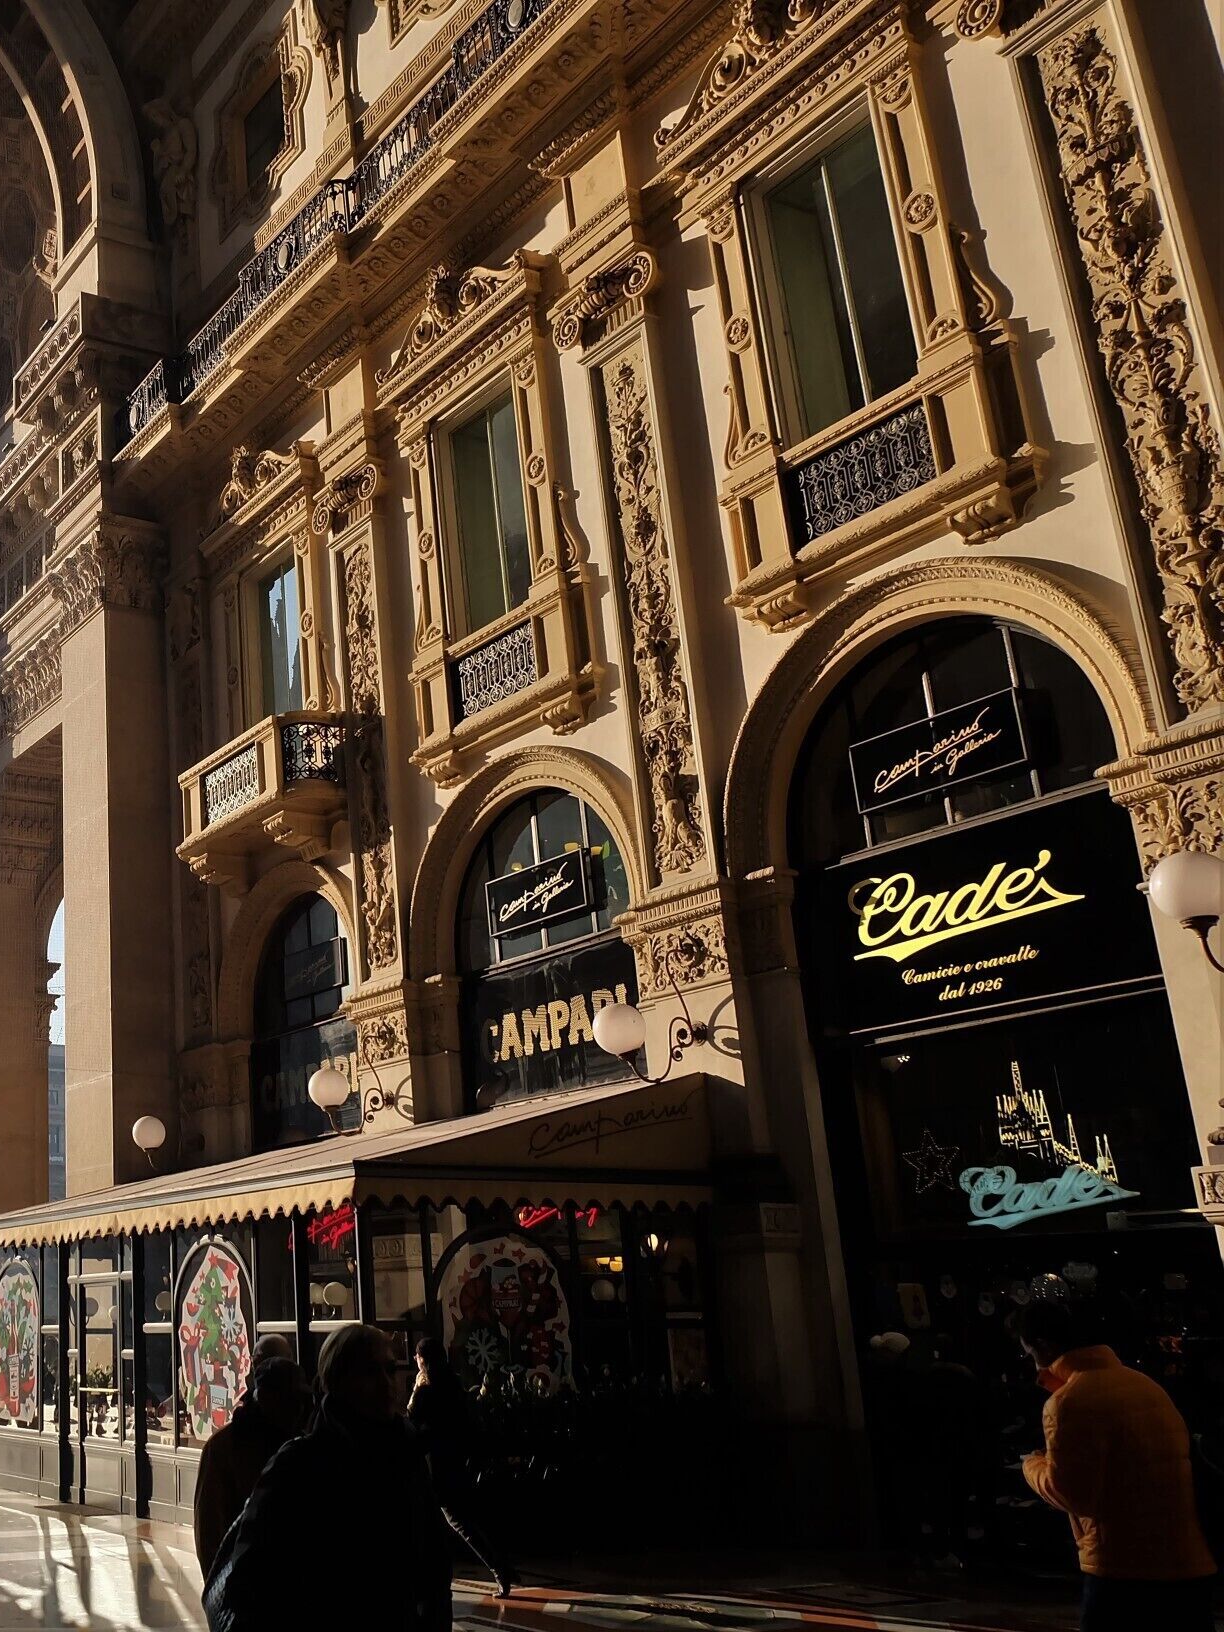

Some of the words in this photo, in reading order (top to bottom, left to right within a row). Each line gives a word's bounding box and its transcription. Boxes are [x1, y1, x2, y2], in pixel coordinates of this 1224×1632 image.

[930, 762, 944, 774] in
[945, 728, 1002, 775] Galleria
[901, 962, 963, 985] Camicie
[963, 961, 975, 973] e
[974, 944, 1040, 971] cravatte
[938, 985, 966, 1001] dal
[968, 977, 1003, 995] 1926
